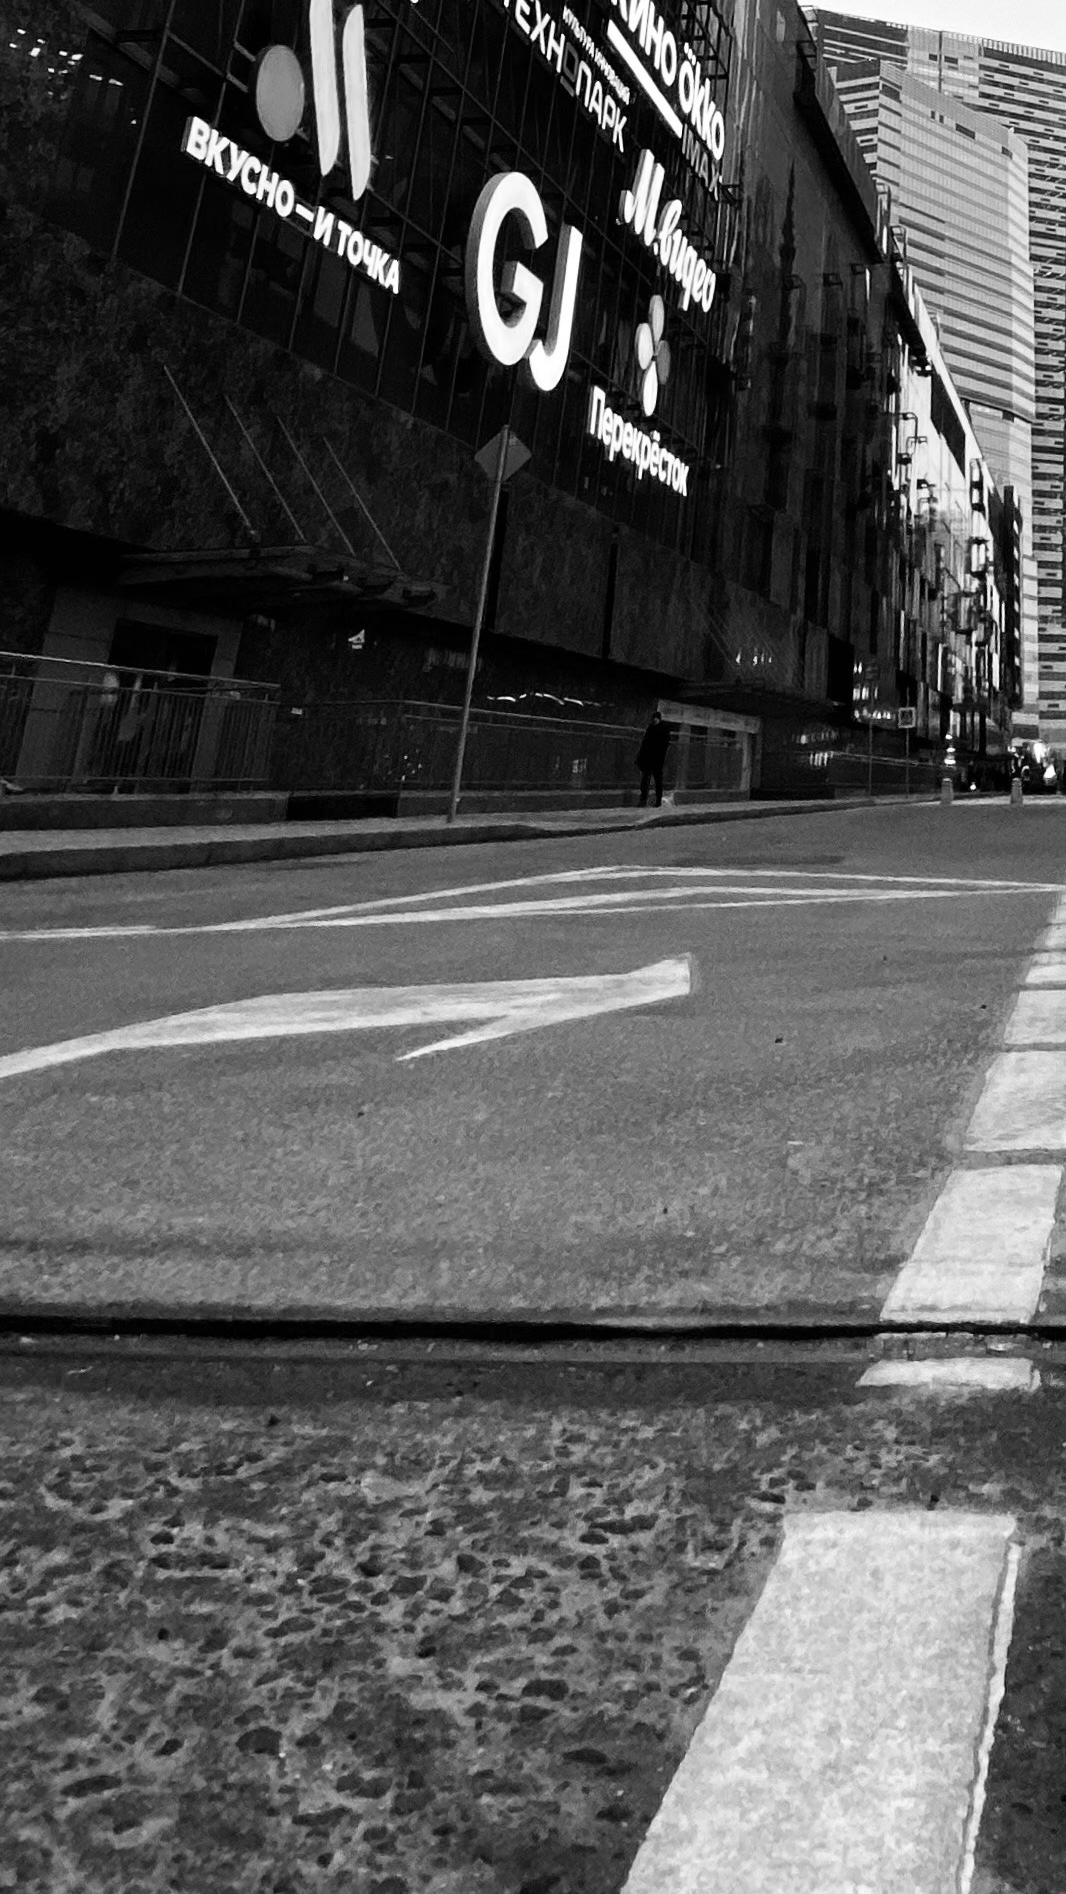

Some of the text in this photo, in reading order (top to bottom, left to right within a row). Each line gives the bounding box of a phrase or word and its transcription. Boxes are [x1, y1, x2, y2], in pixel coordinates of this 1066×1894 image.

[682, 123, 722, 202] IMAX
[335, 219, 401, 295] ТОЧКА
[466, 171, 584, 392] GJ
[588, 385, 689, 497] Перекрёсток
